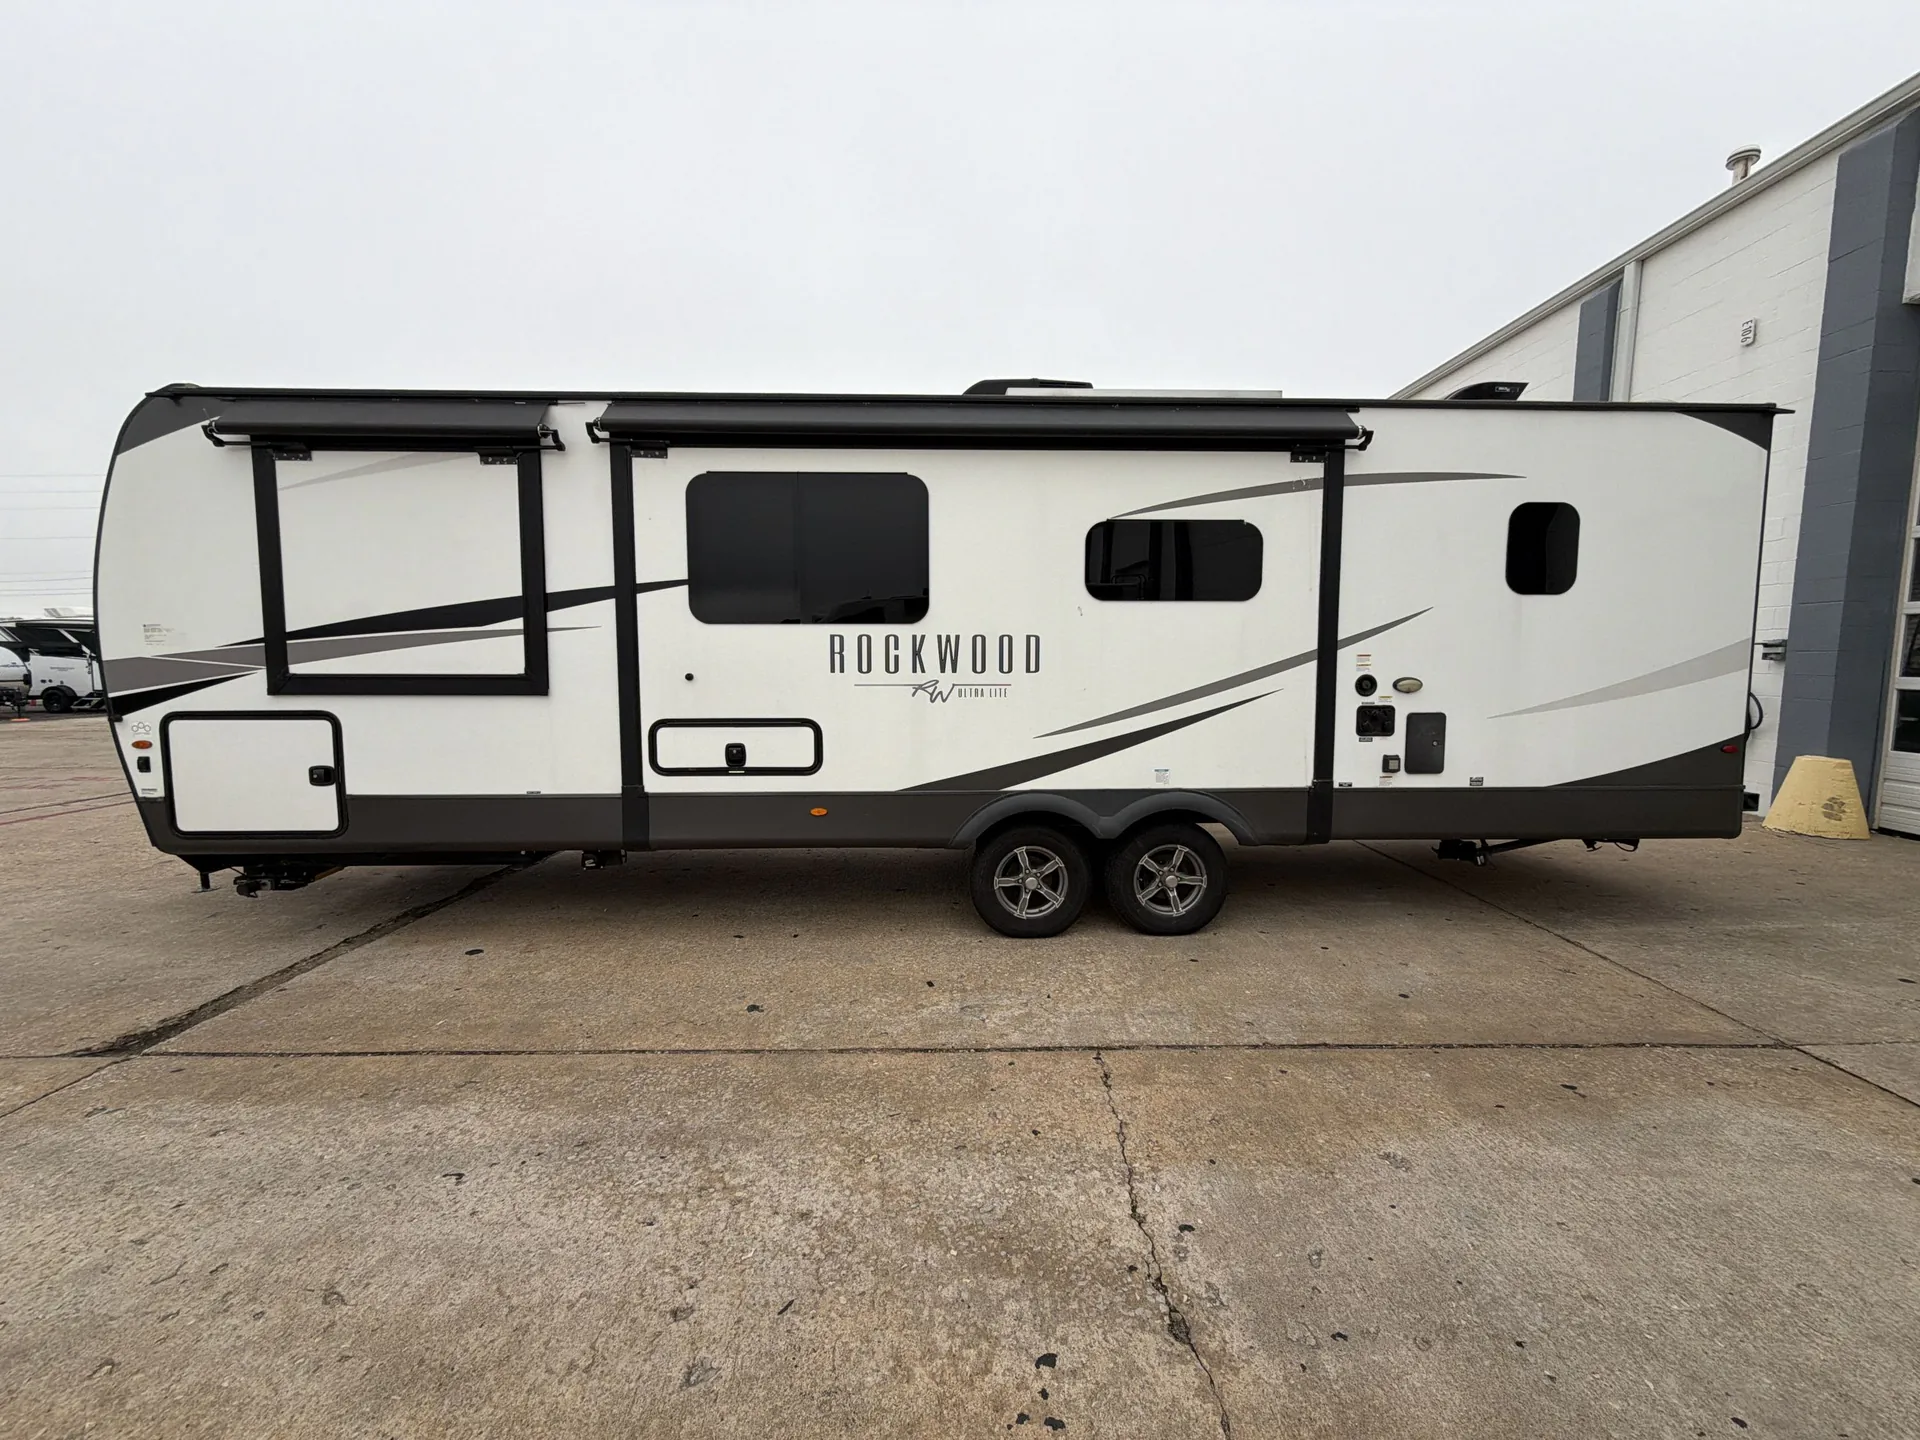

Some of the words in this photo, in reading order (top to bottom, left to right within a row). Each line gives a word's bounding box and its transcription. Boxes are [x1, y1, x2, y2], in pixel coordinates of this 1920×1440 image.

[829, 634, 1041, 675] ROCKWOOD
[911, 679, 955, 704] RW
[957, 687, 985, 698] ULTRA
[989, 687, 1008, 698] LITE
